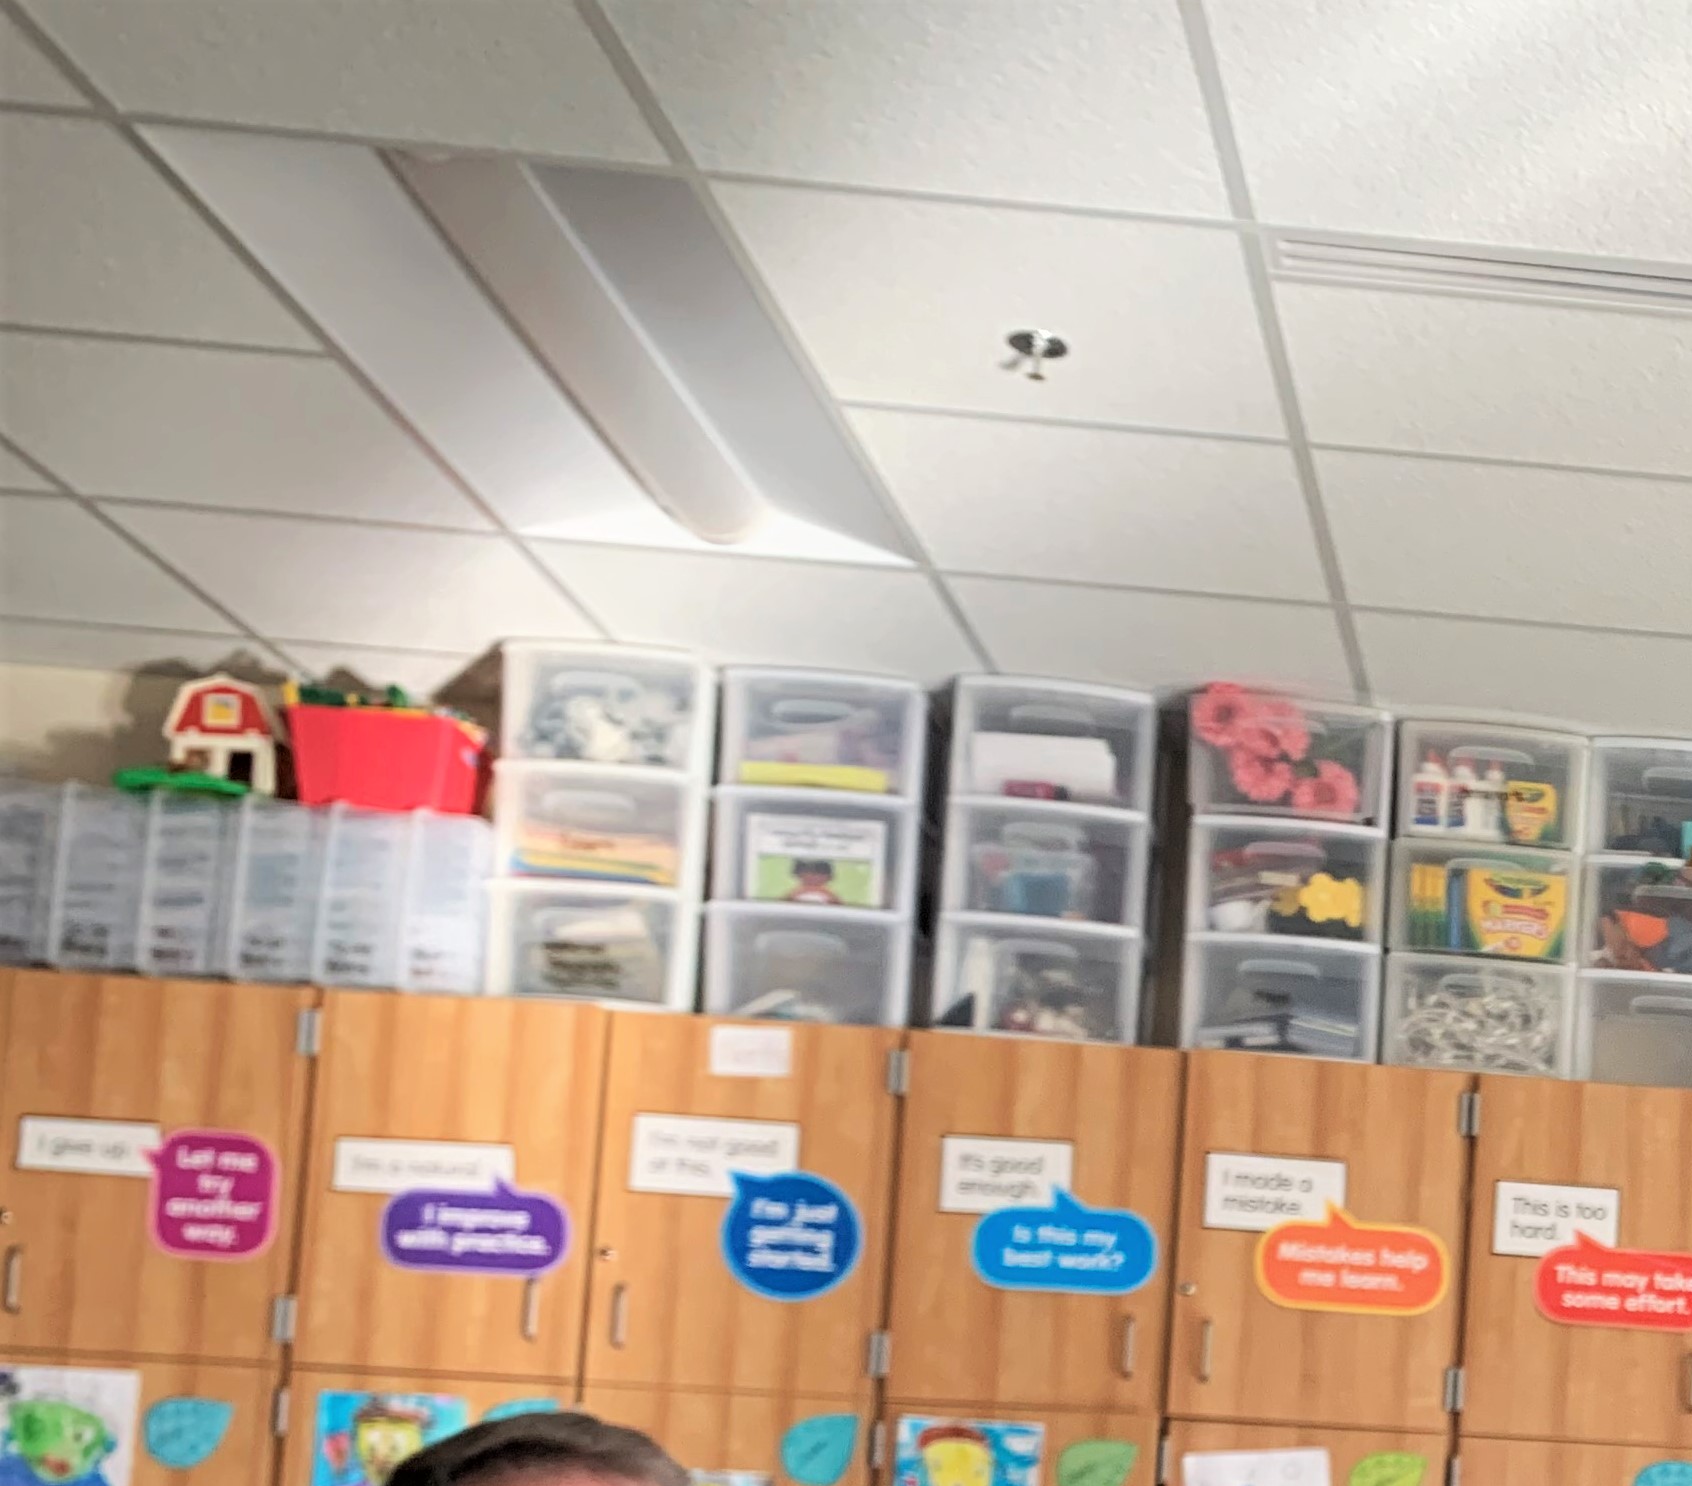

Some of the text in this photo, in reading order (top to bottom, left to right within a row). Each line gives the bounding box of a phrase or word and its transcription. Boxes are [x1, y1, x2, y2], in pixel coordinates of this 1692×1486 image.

[175, 1144, 216, 1171] Let
[1233, 1171, 1294, 1191] made
[1299, 1177, 1313, 1193] a
[1511, 1196, 1608, 1222] This is too
[1012, 1223, 1118, 1253] Is this my
[1002, 1247, 1126, 1273] best work?
[1276, 1241, 1430, 1274] Mistakes help
[1298, 1269, 1336, 1289] me
[1553, 1263, 1597, 1286] This
[1601, 1271, 1650, 1295] may
[1560, 1292, 1691, 1316] some effort.
